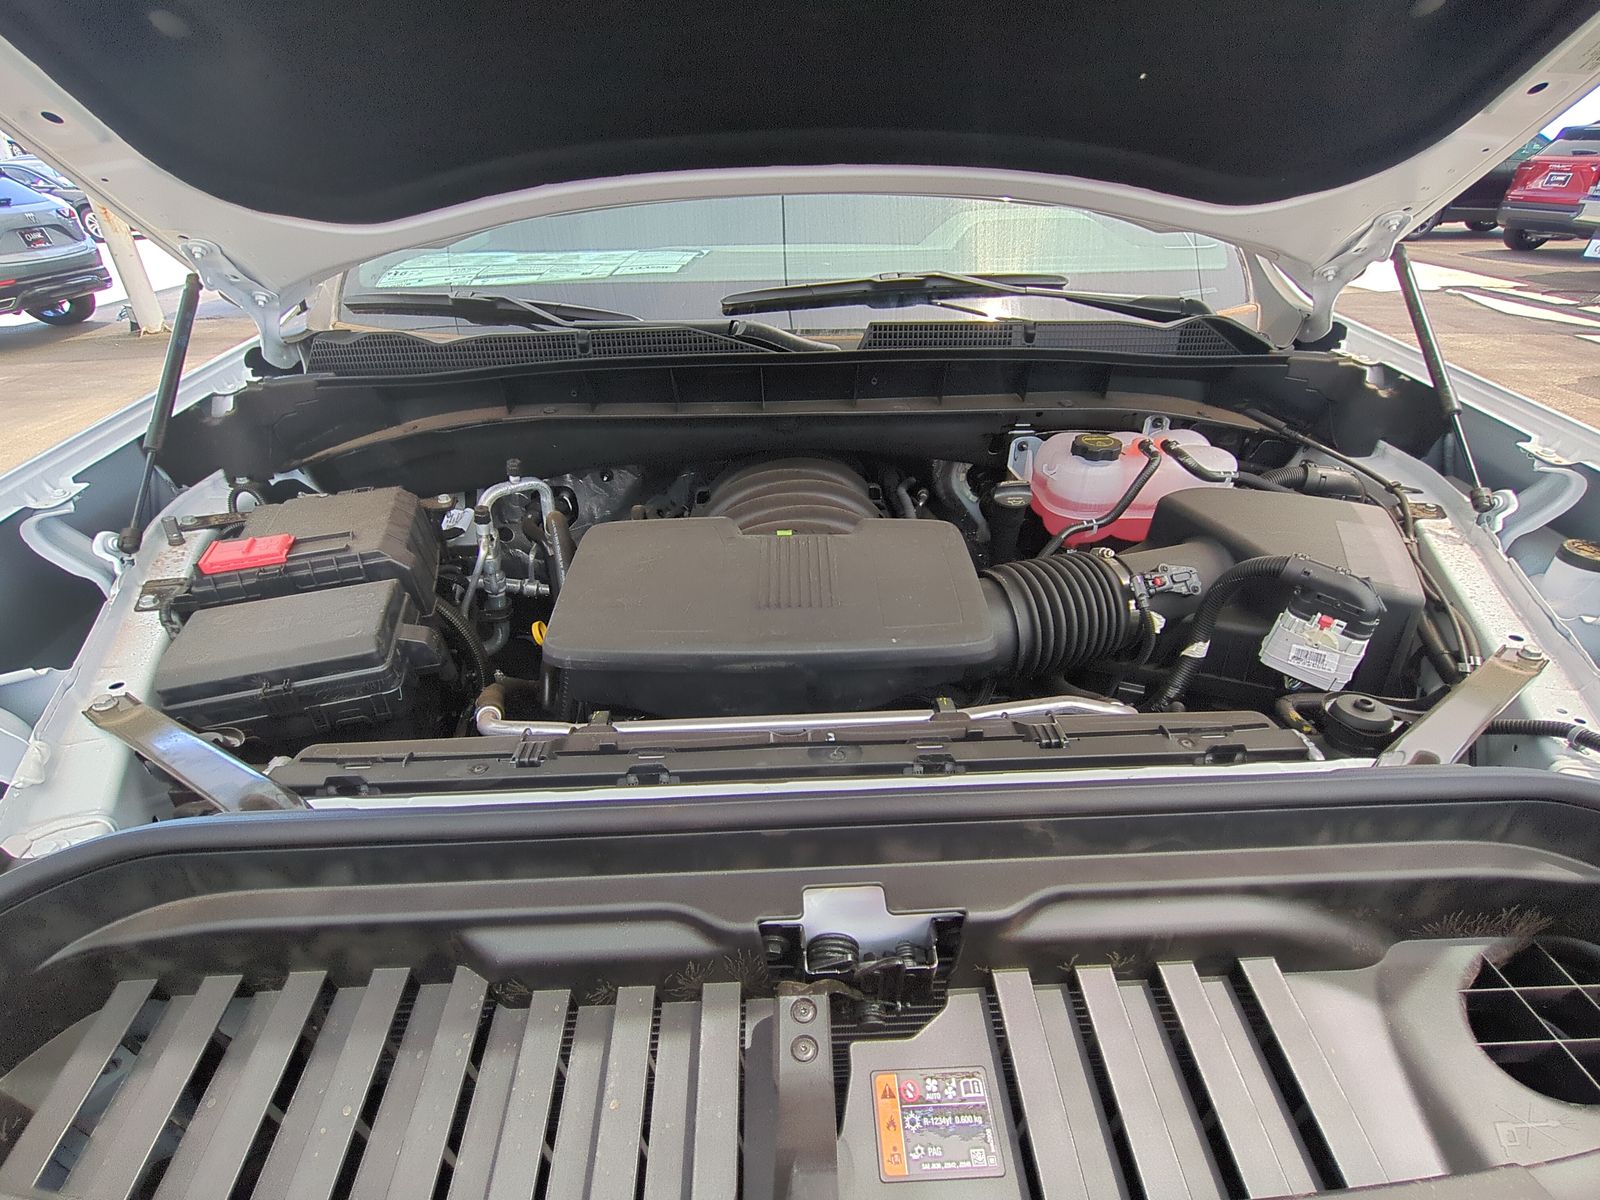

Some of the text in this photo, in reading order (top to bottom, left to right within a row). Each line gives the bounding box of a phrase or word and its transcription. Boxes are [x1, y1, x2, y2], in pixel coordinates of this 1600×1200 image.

[926, 1092, 941, 1100] AUTO
[954, 1114, 973, 1124] 0.600
[973, 1114, 982, 1124] kg
[927, 1146, 943, 1157] PAG
